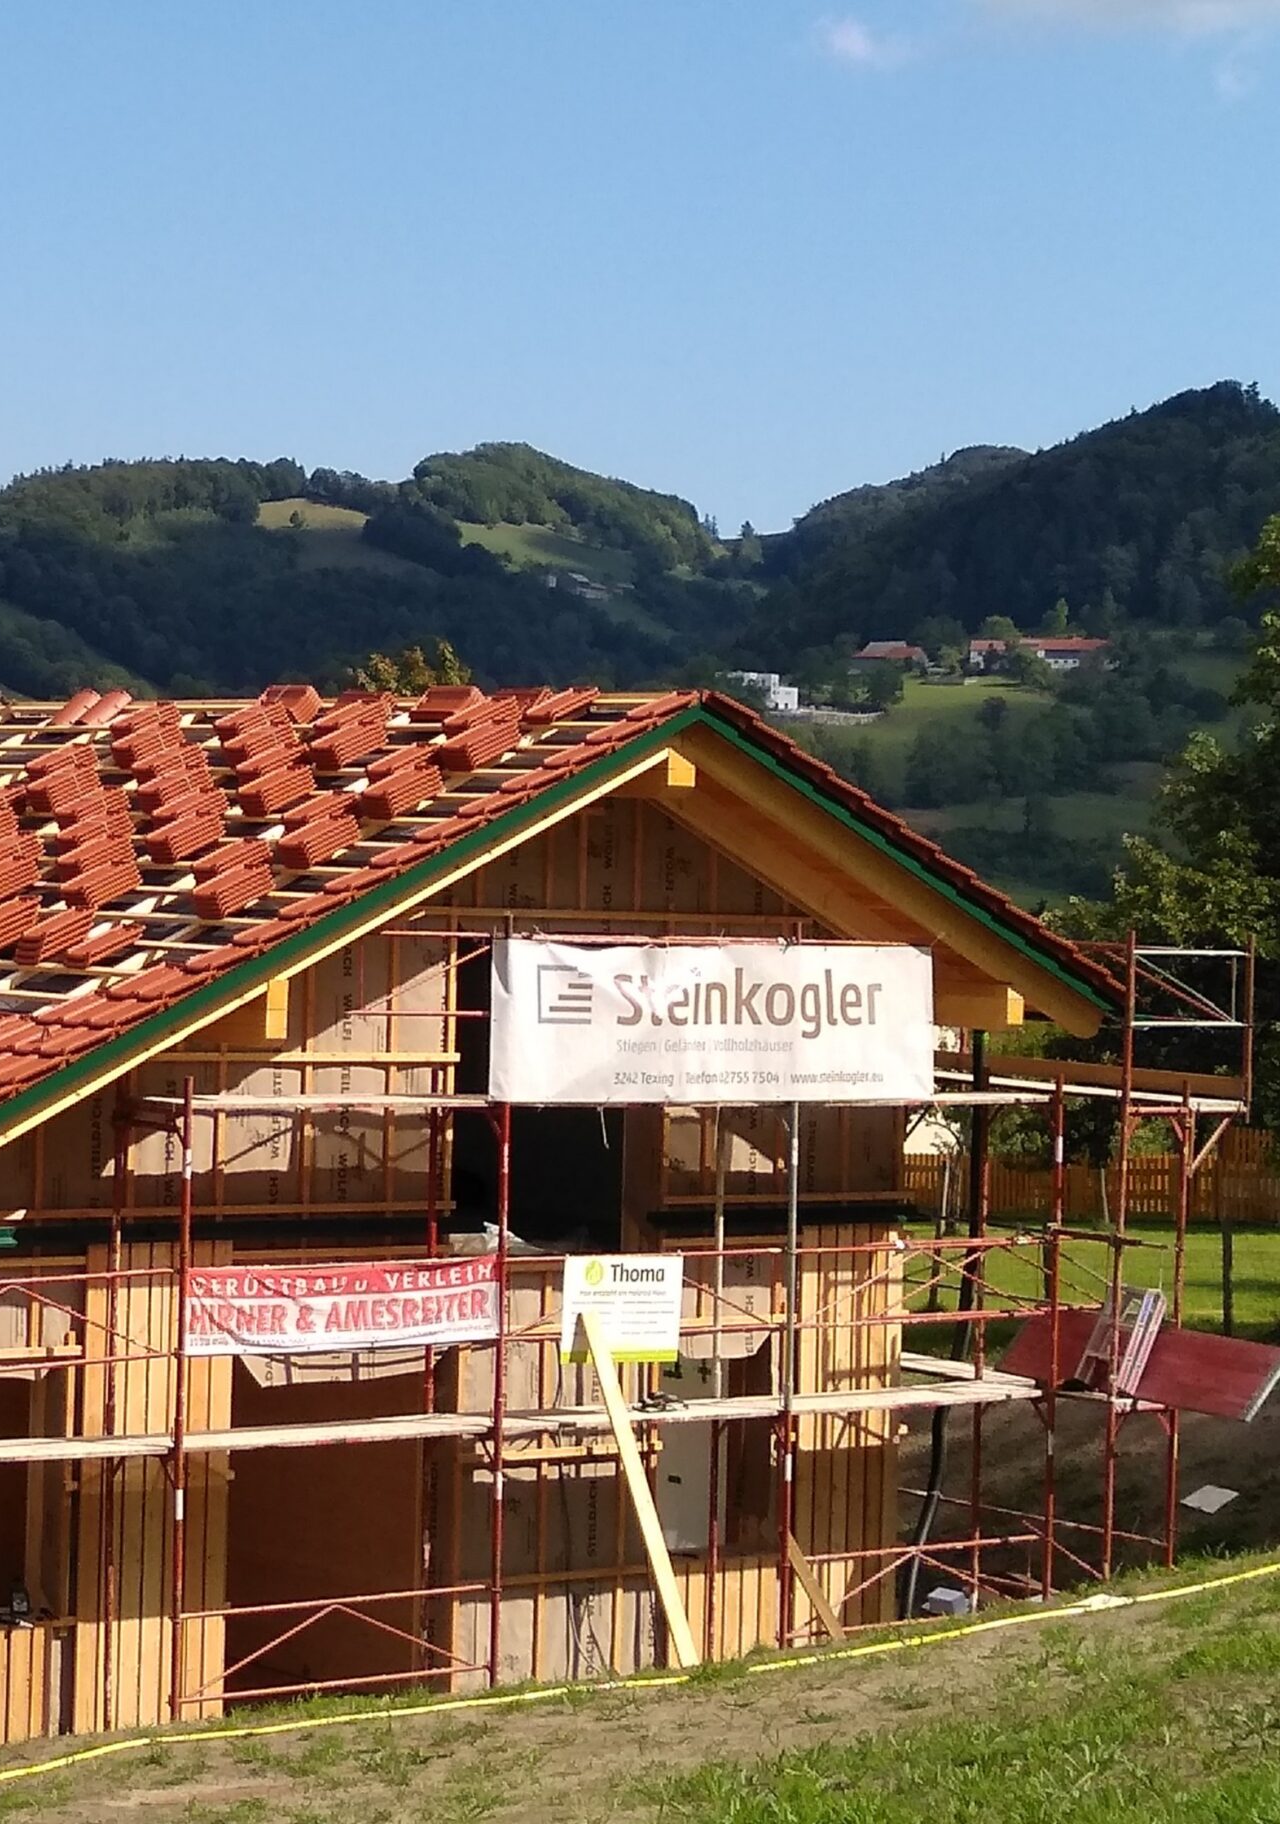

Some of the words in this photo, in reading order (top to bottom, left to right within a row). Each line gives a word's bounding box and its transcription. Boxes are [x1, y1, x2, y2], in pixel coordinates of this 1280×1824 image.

[614, 967, 883, 1039] Steinkogler
[385, 1263, 494, 1291] VERLEIH
[610, 1262, 665, 1282] Thoma
[296, 1303, 316, 1334] &
[324, 1289, 490, 1332] AMESREITER
